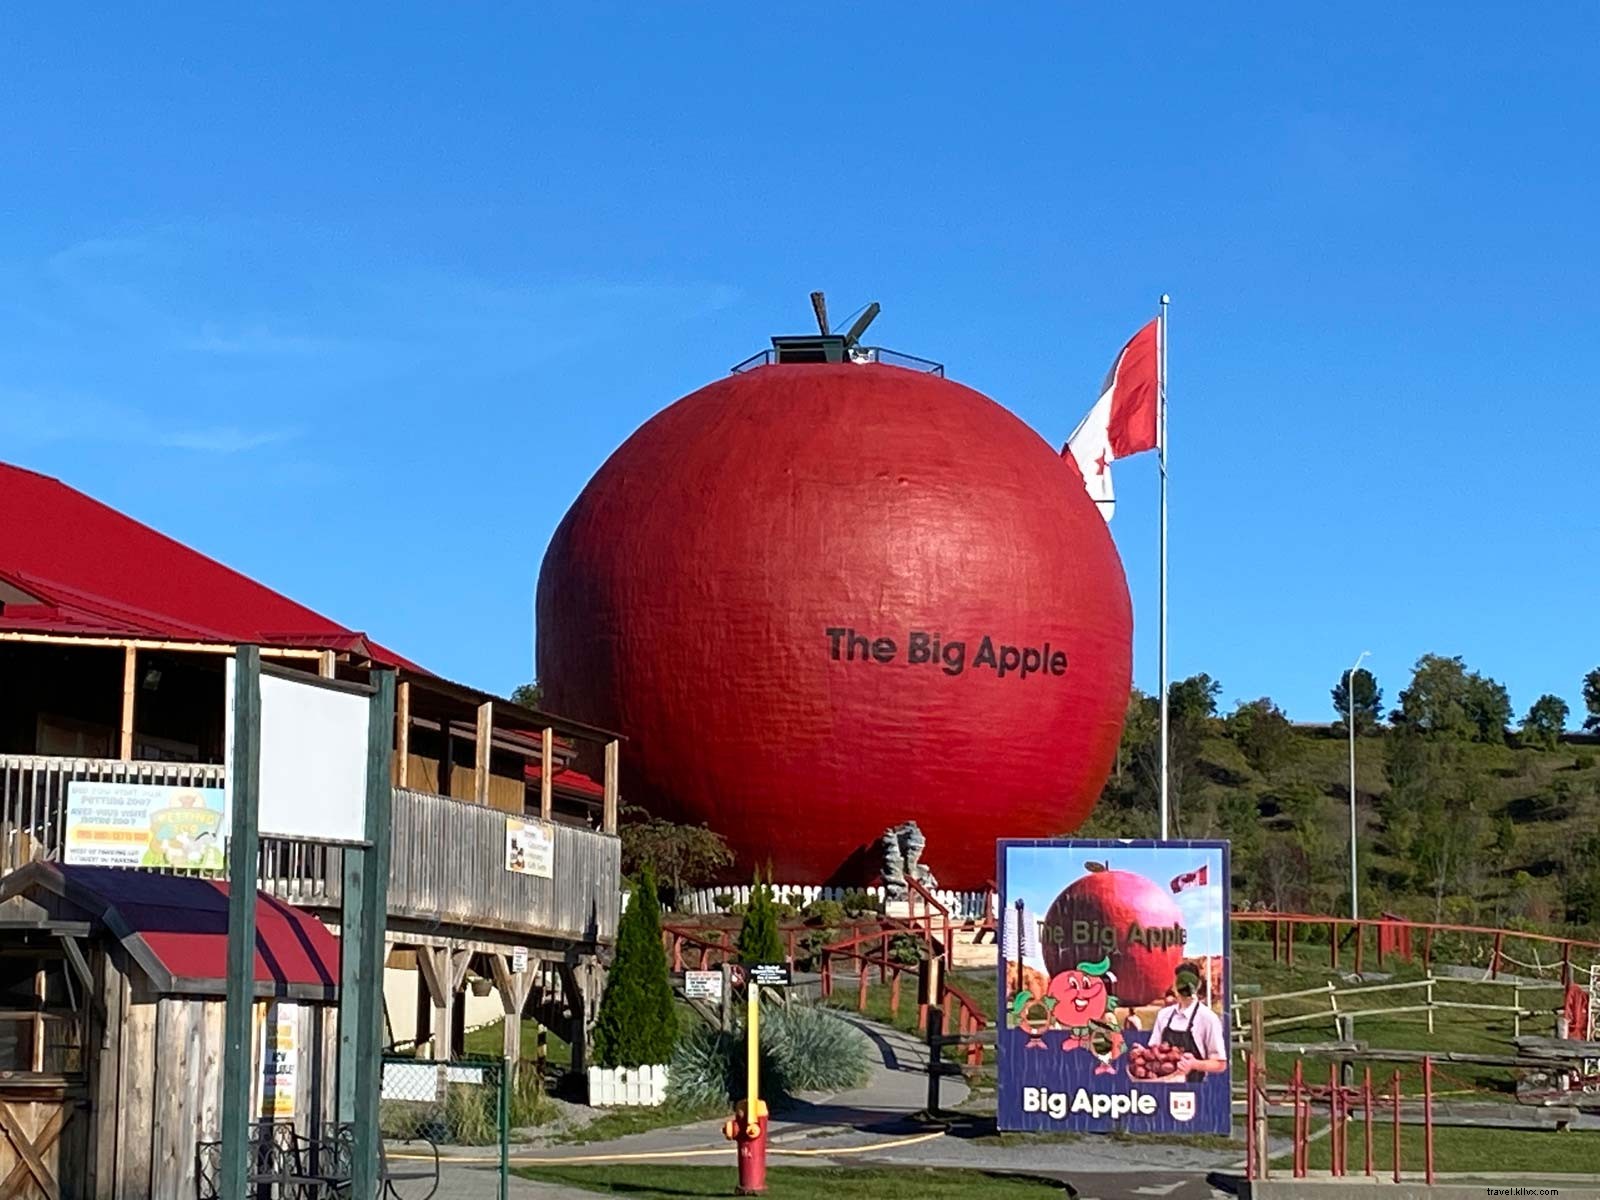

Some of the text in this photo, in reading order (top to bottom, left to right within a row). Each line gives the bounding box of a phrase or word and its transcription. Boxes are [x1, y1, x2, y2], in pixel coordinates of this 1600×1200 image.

[825, 627, 1068, 680] The Big Apple
[1072, 921, 1117, 951] Big
[1127, 921, 1187, 952] Apple
[1023, 1087, 1157, 1119] Big Apple
